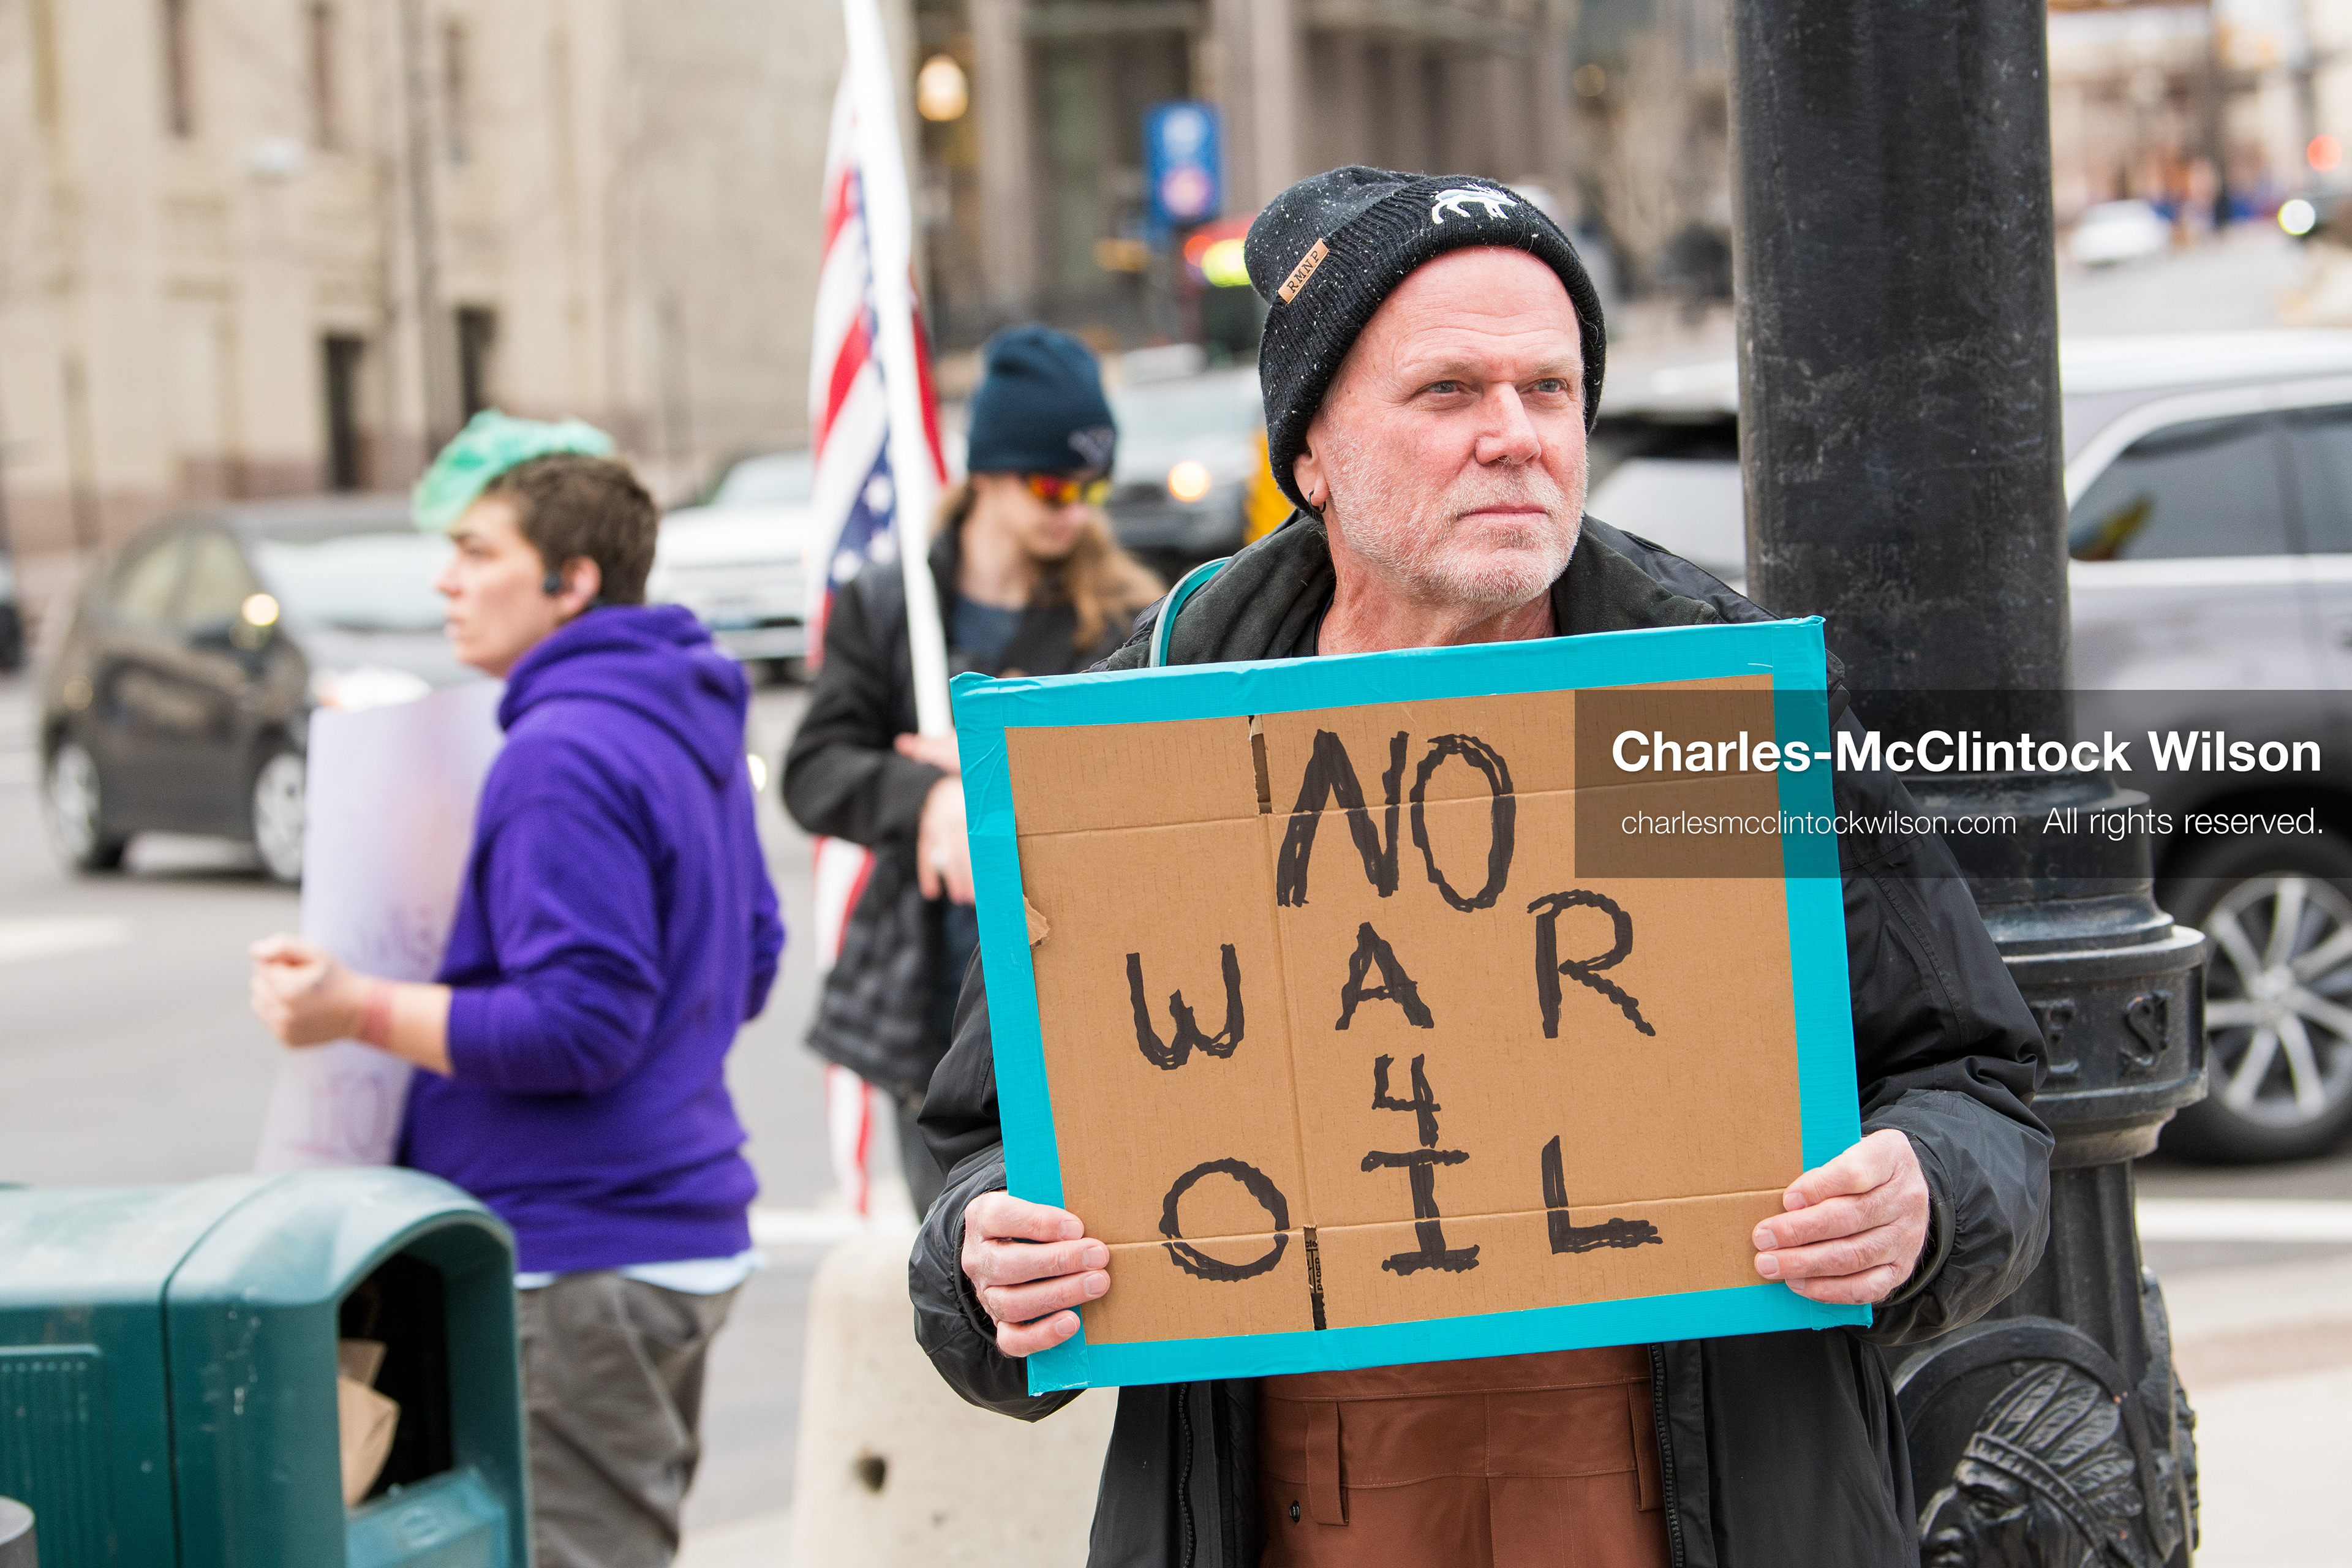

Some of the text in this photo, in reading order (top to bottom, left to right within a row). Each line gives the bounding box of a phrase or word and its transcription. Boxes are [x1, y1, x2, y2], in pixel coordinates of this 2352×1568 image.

[1287, 251, 1319, 293] RMNP
[1277, 729, 1516, 913] NO
[1126, 889, 1656, 1070] WAR
[1372, 1054, 1441, 1147] 4
[1159, 1136, 1662, 1282] OIL
